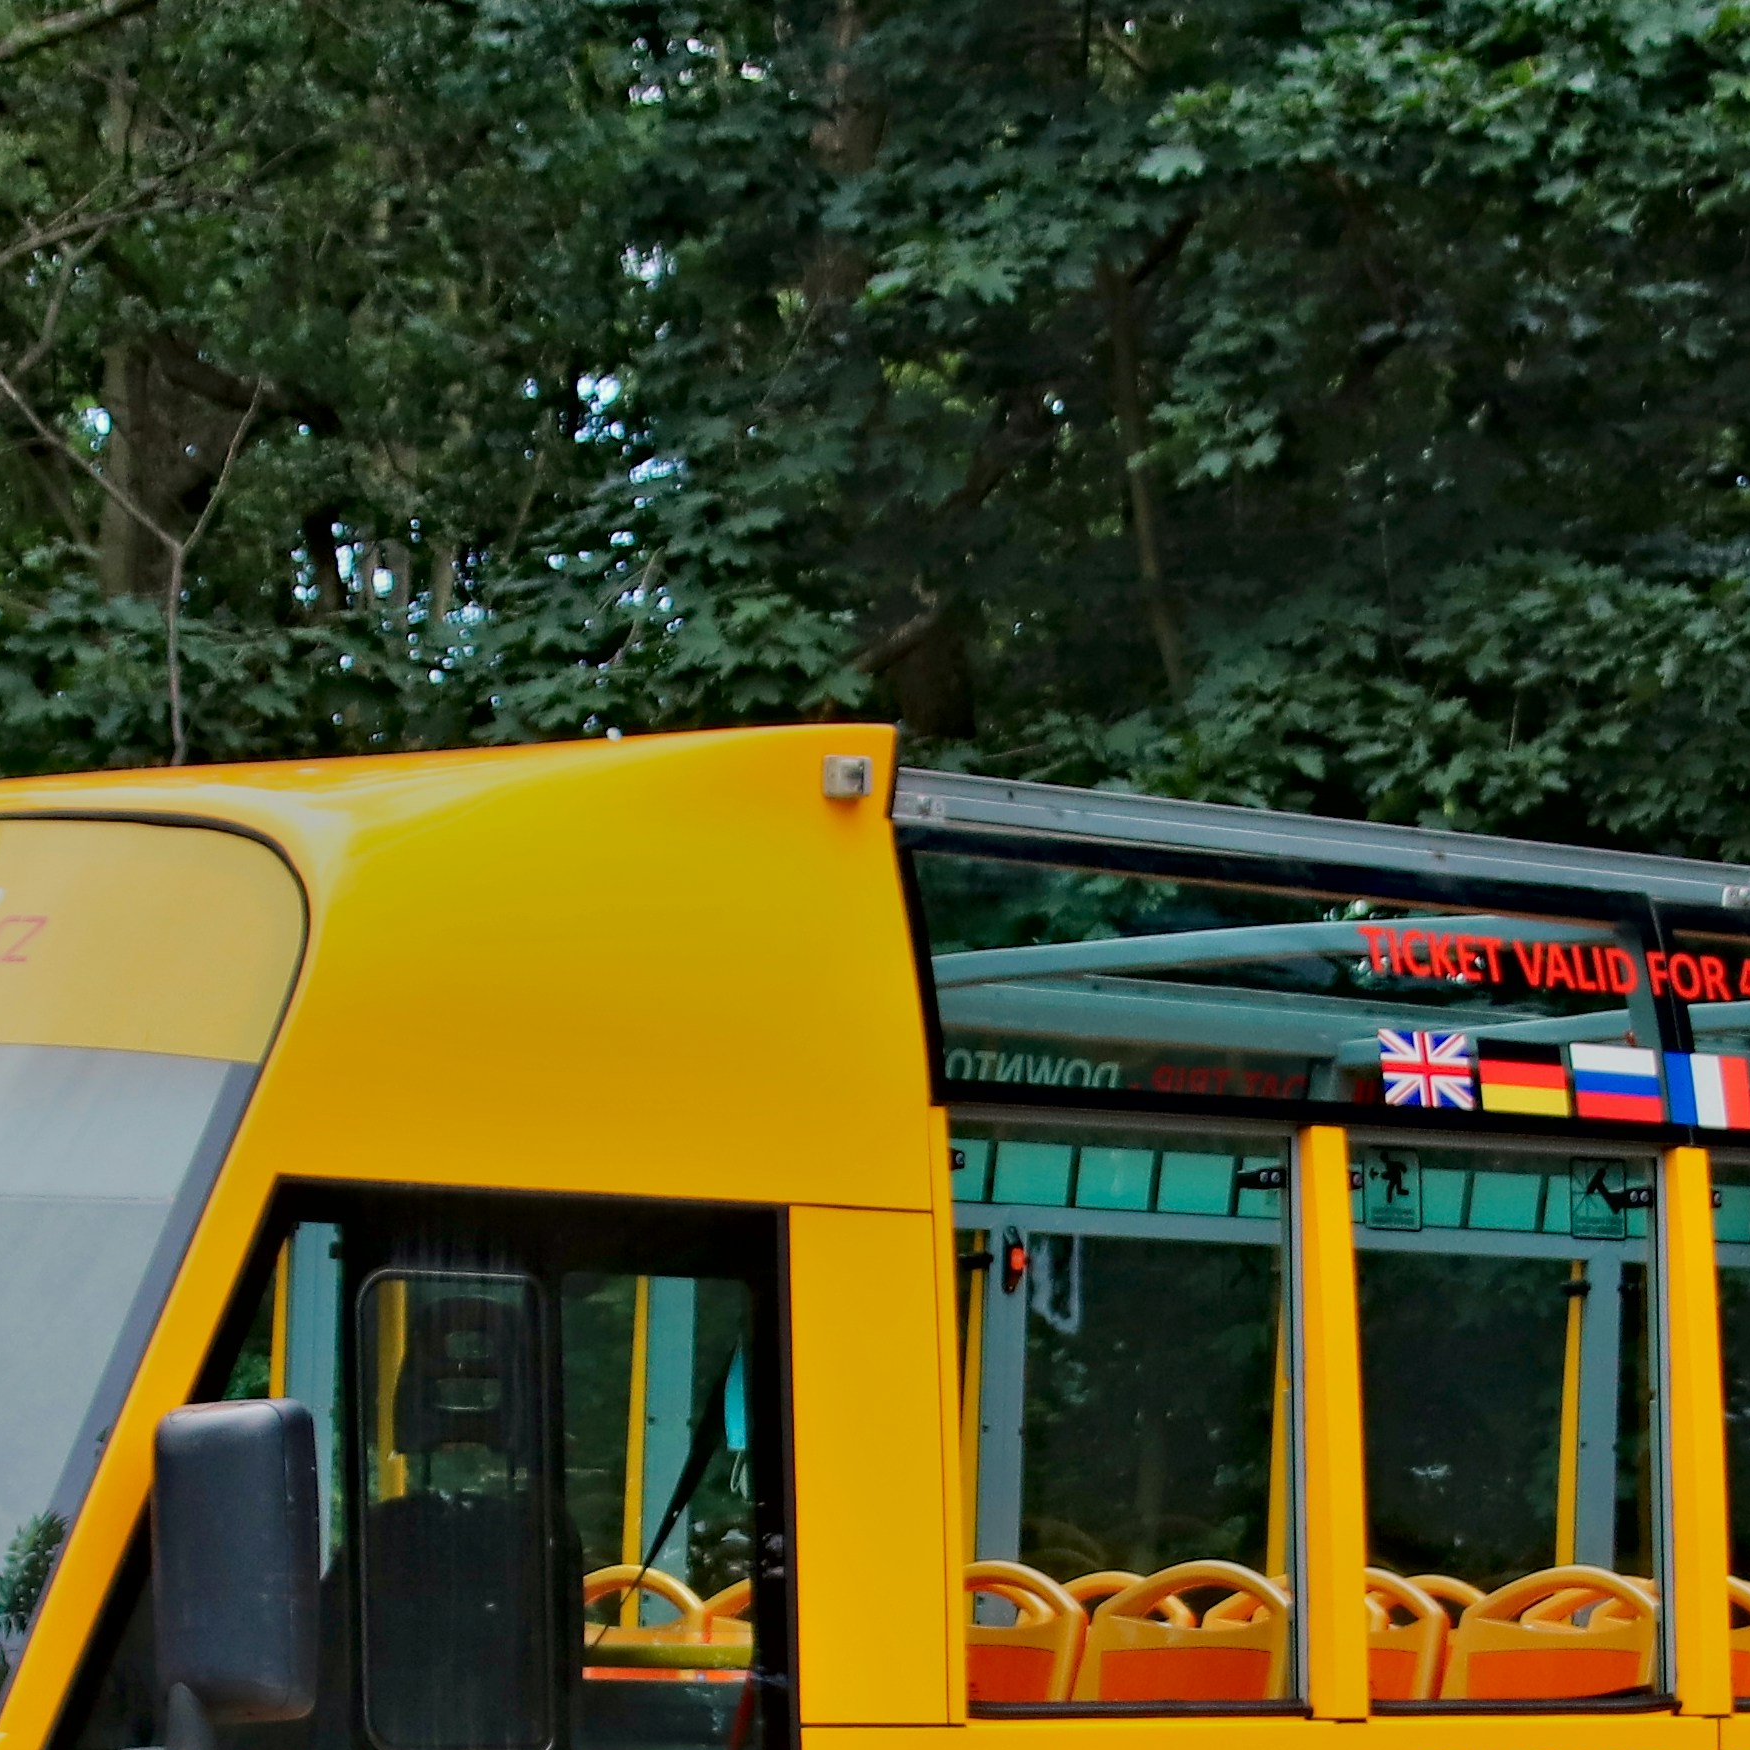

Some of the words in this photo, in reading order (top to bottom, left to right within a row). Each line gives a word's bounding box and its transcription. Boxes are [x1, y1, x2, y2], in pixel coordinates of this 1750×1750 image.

[1358, 924, 1505, 985] TICKET
[1514, 939, 1637, 996] VALID
[1650, 950, 1732, 1002] FOR
